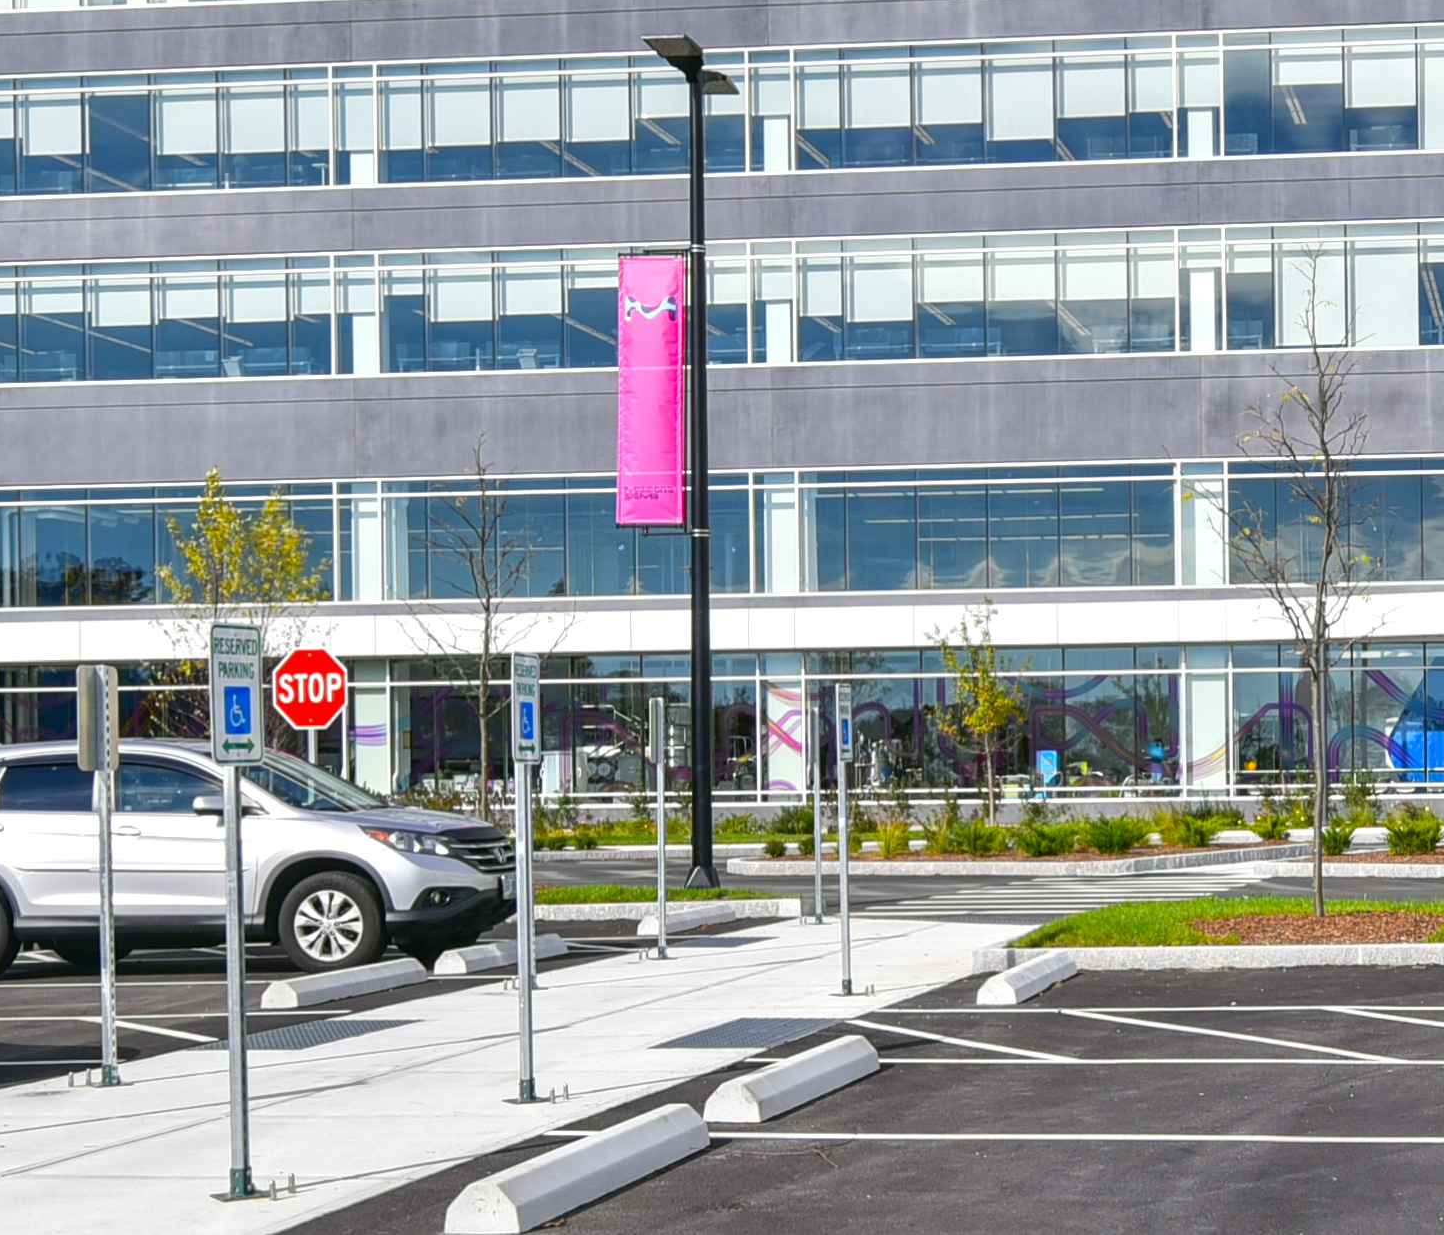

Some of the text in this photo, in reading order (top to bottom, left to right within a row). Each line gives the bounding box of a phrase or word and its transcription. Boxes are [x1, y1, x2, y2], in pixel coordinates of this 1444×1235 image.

[214, 637, 257, 656] RESERVED
[218, 661, 254, 680] PARKING
[278, 673, 342, 704] STOP
